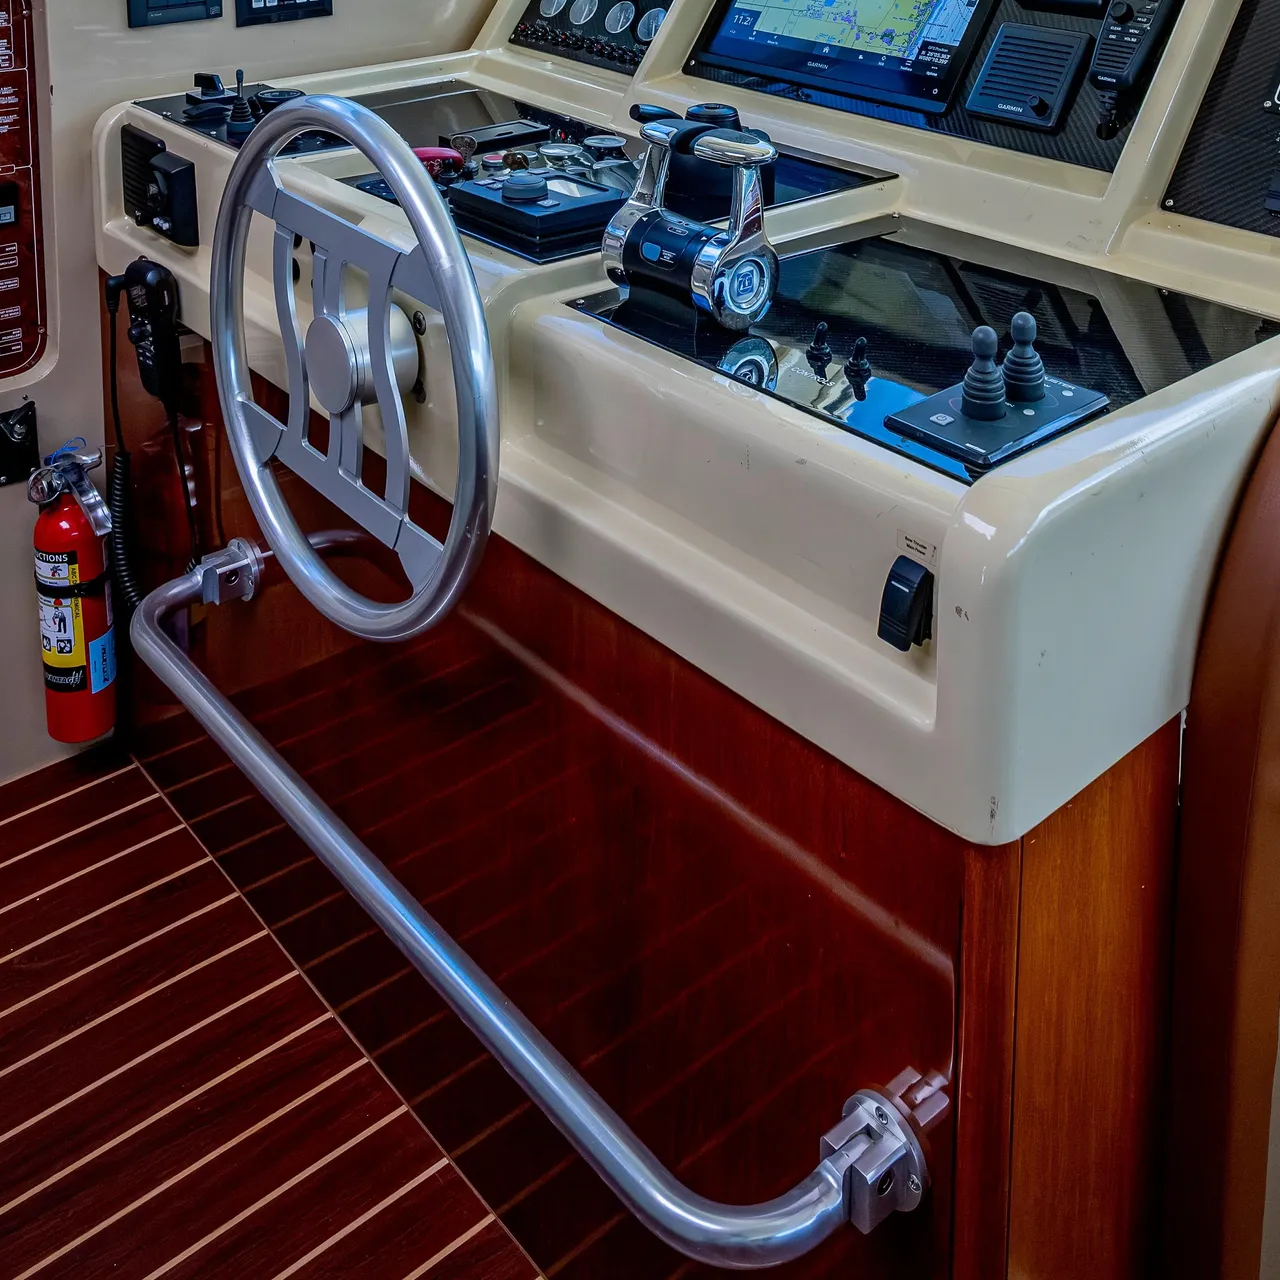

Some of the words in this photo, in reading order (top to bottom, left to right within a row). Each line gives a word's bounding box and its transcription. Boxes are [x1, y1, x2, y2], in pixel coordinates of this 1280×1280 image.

[806, 60, 829, 70] GARMIN
[1097, 75, 1117, 83] GARMIN
[997, 103, 1023, 113] GARMIN
[790, 366, 836, 387] CONTROLS
